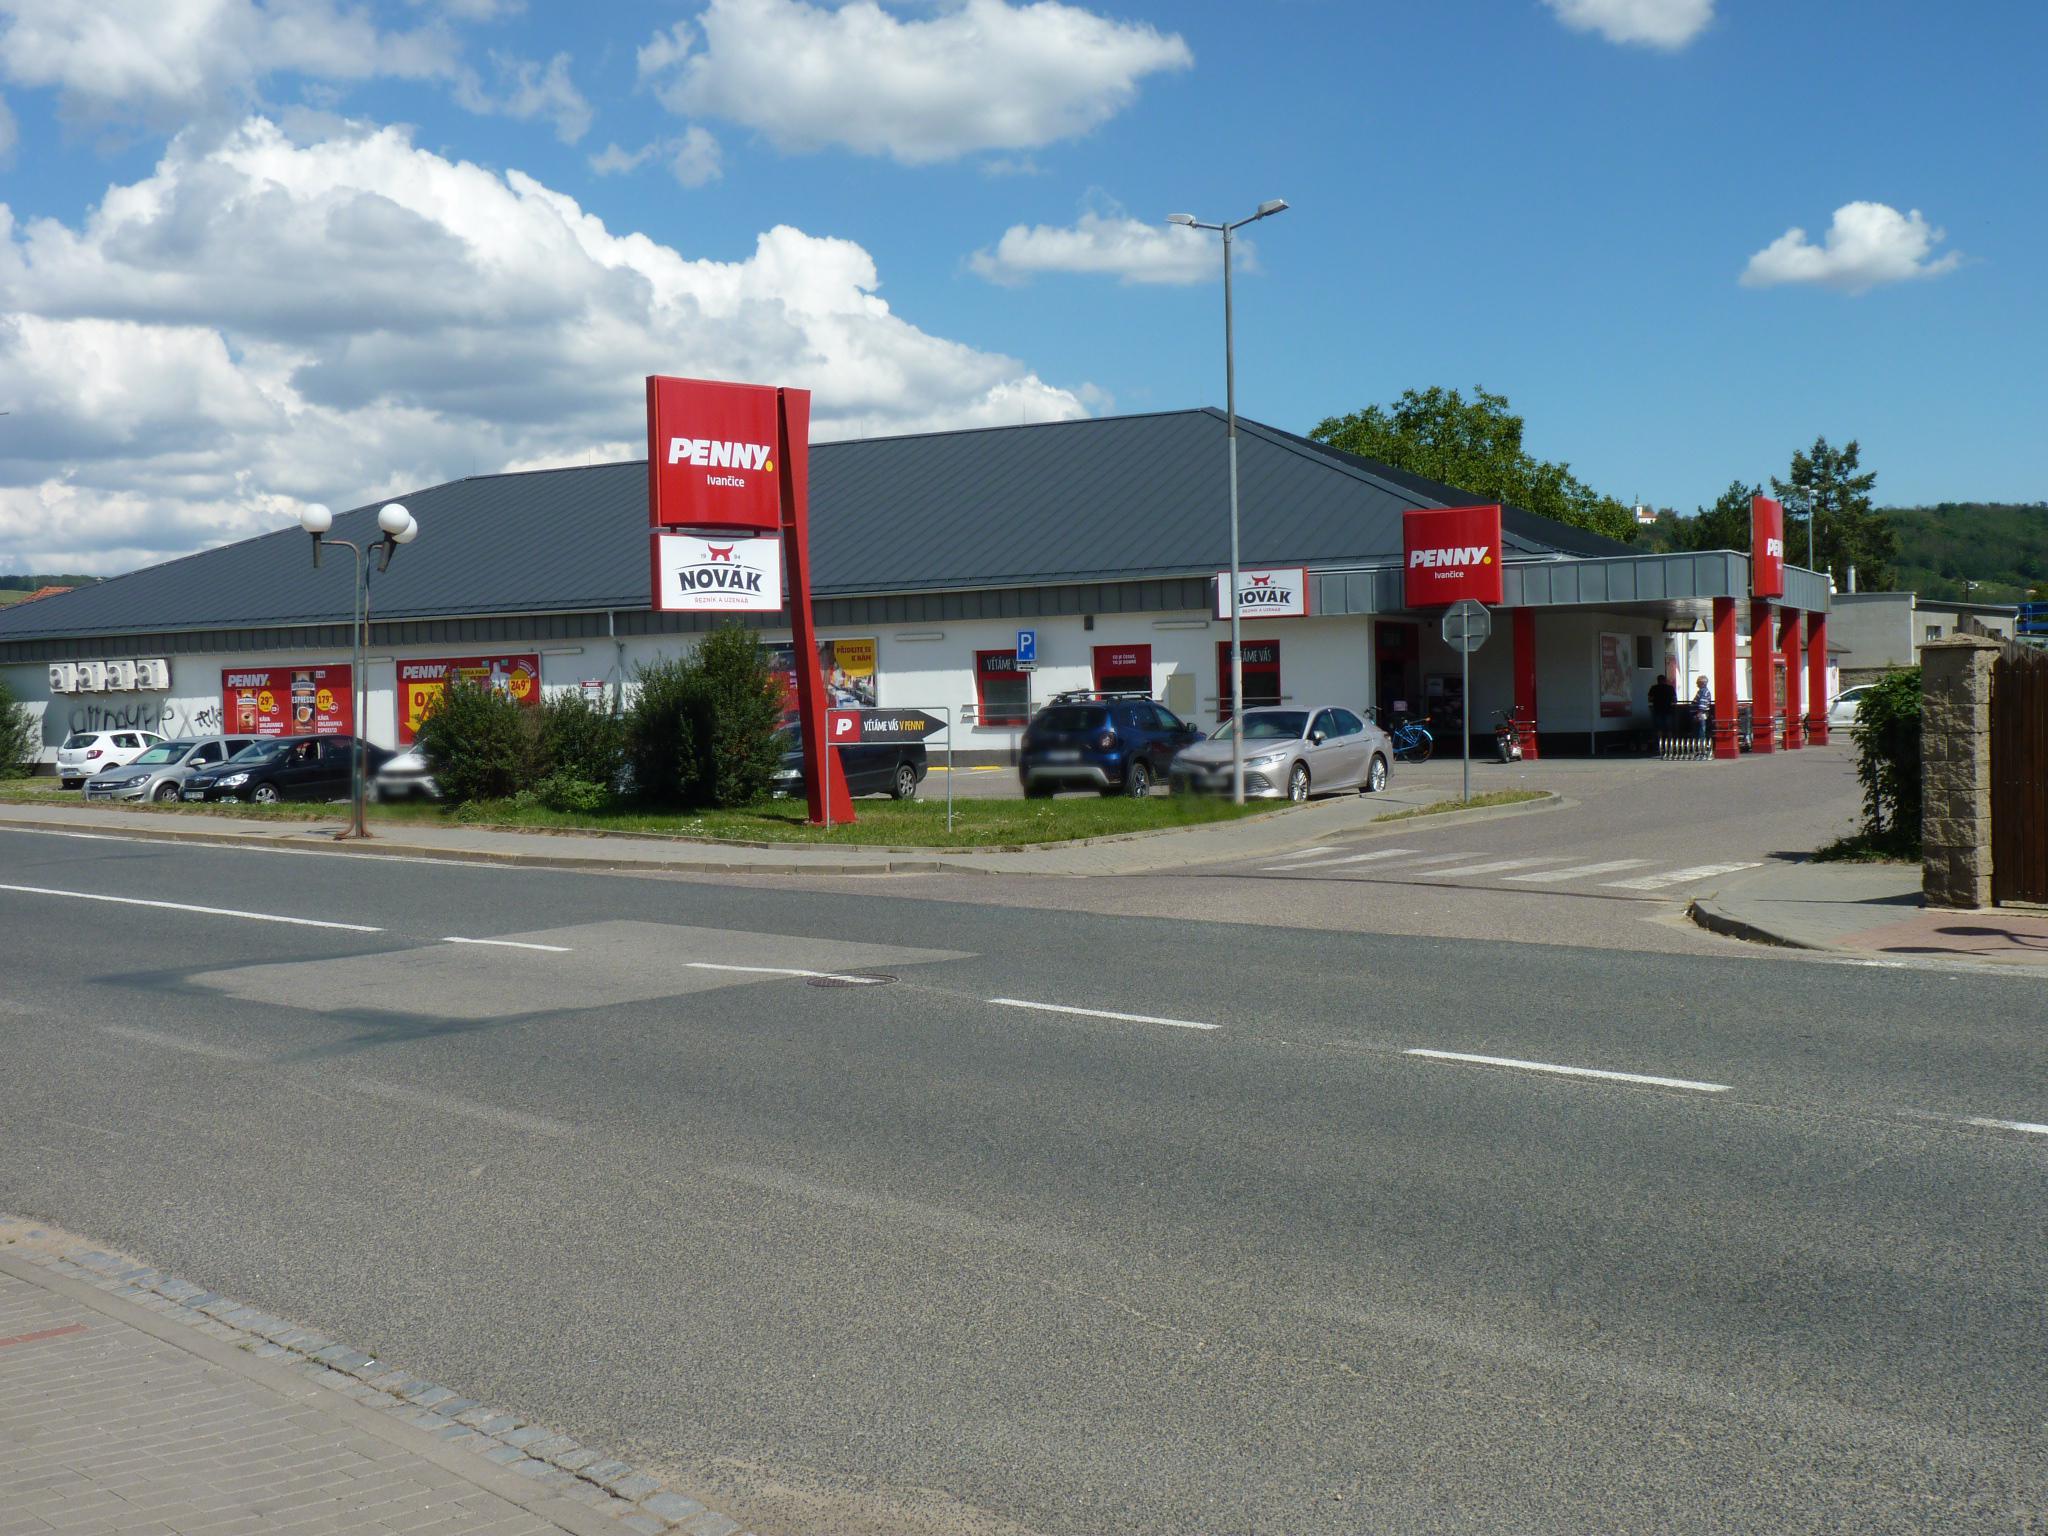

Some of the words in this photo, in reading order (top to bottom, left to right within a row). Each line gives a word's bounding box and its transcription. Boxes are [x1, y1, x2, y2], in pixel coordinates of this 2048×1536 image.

[707, 474, 745, 487] Ivančice
[678, 564, 762, 592] NOVÁK
[1434, 570, 1464, 579] Ivančice
[1020, 633, 1032, 652] P
[835, 719, 852, 735] P
[864, 718, 888, 731] VÍTÁME
[888, 718, 899, 731] VÁS
[899, 720, 905, 731] V
[905, 720, 925, 731] PENNY
